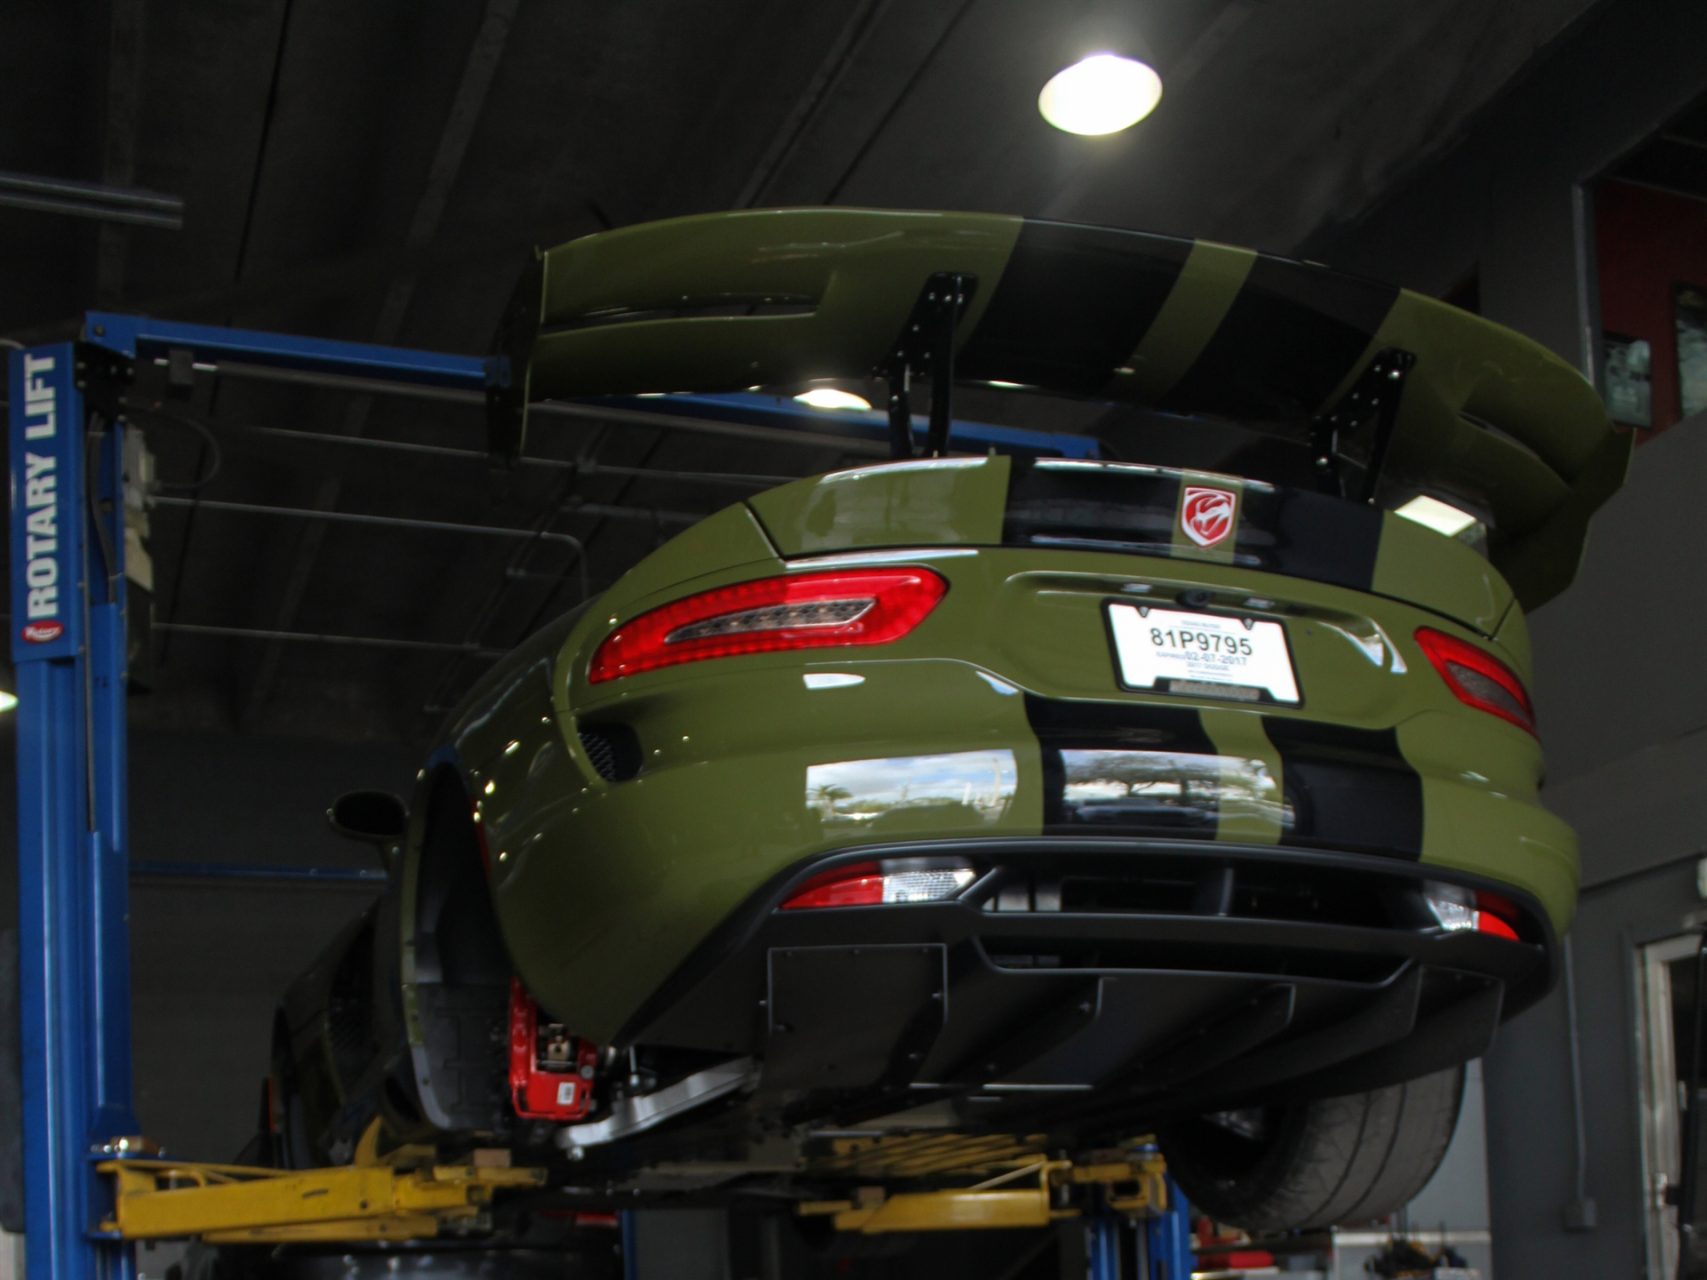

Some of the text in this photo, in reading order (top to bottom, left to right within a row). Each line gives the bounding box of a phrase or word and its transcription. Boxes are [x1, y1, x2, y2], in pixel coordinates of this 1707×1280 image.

[24, 354, 57, 440] LIFT
[25, 452, 59, 619] ROTARY
[1149, 627, 1253, 656] 81P9795
